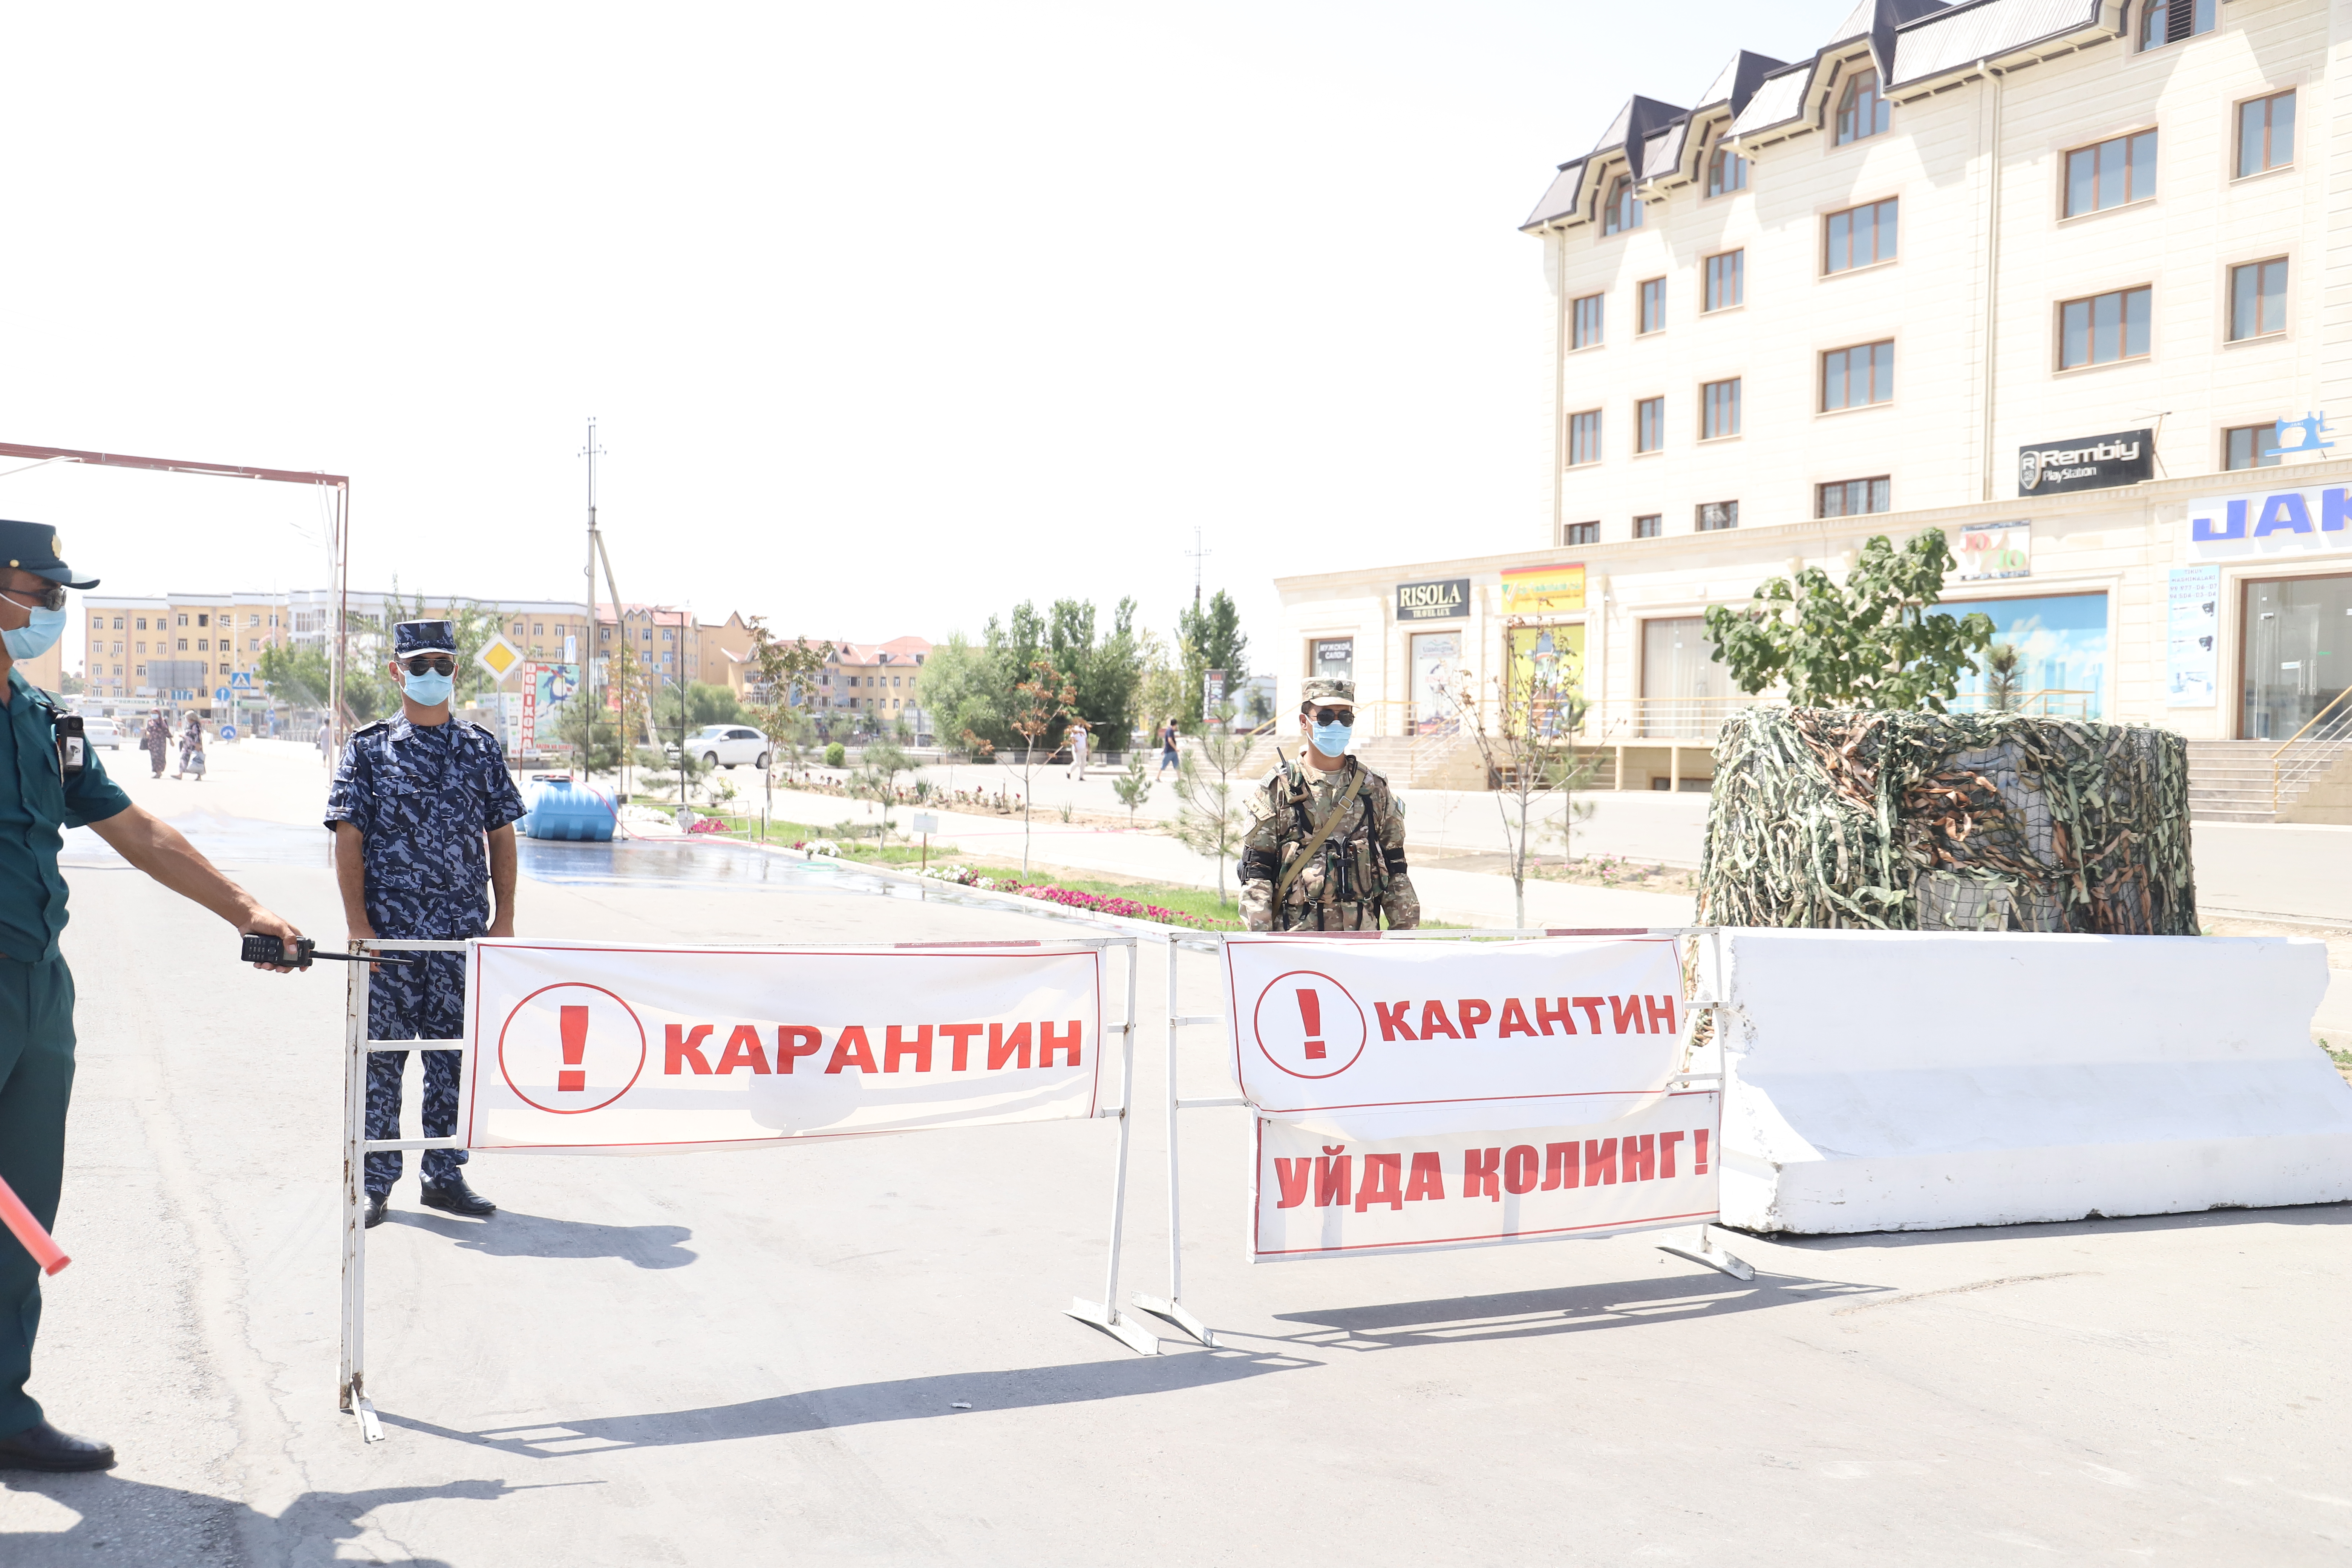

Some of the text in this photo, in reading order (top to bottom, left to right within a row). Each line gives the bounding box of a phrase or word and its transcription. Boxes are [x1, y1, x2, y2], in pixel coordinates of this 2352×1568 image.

[2041, 439, 2140, 468] Rembiy
[2042, 467, 2097, 484] PlayStation
[1400, 583, 1462, 607] RISOLA
[1437, 608, 1450, 616] LUX
[1325, 651, 1346, 660] САЛОН
[522, 663, 537, 749] DORIXONA
[1374, 995, 1676, 1041] КАРАНТИН
[665, 1020, 1082, 1075] КАРАНТИН
[1274, 1145, 1445, 1213] УЙДА
